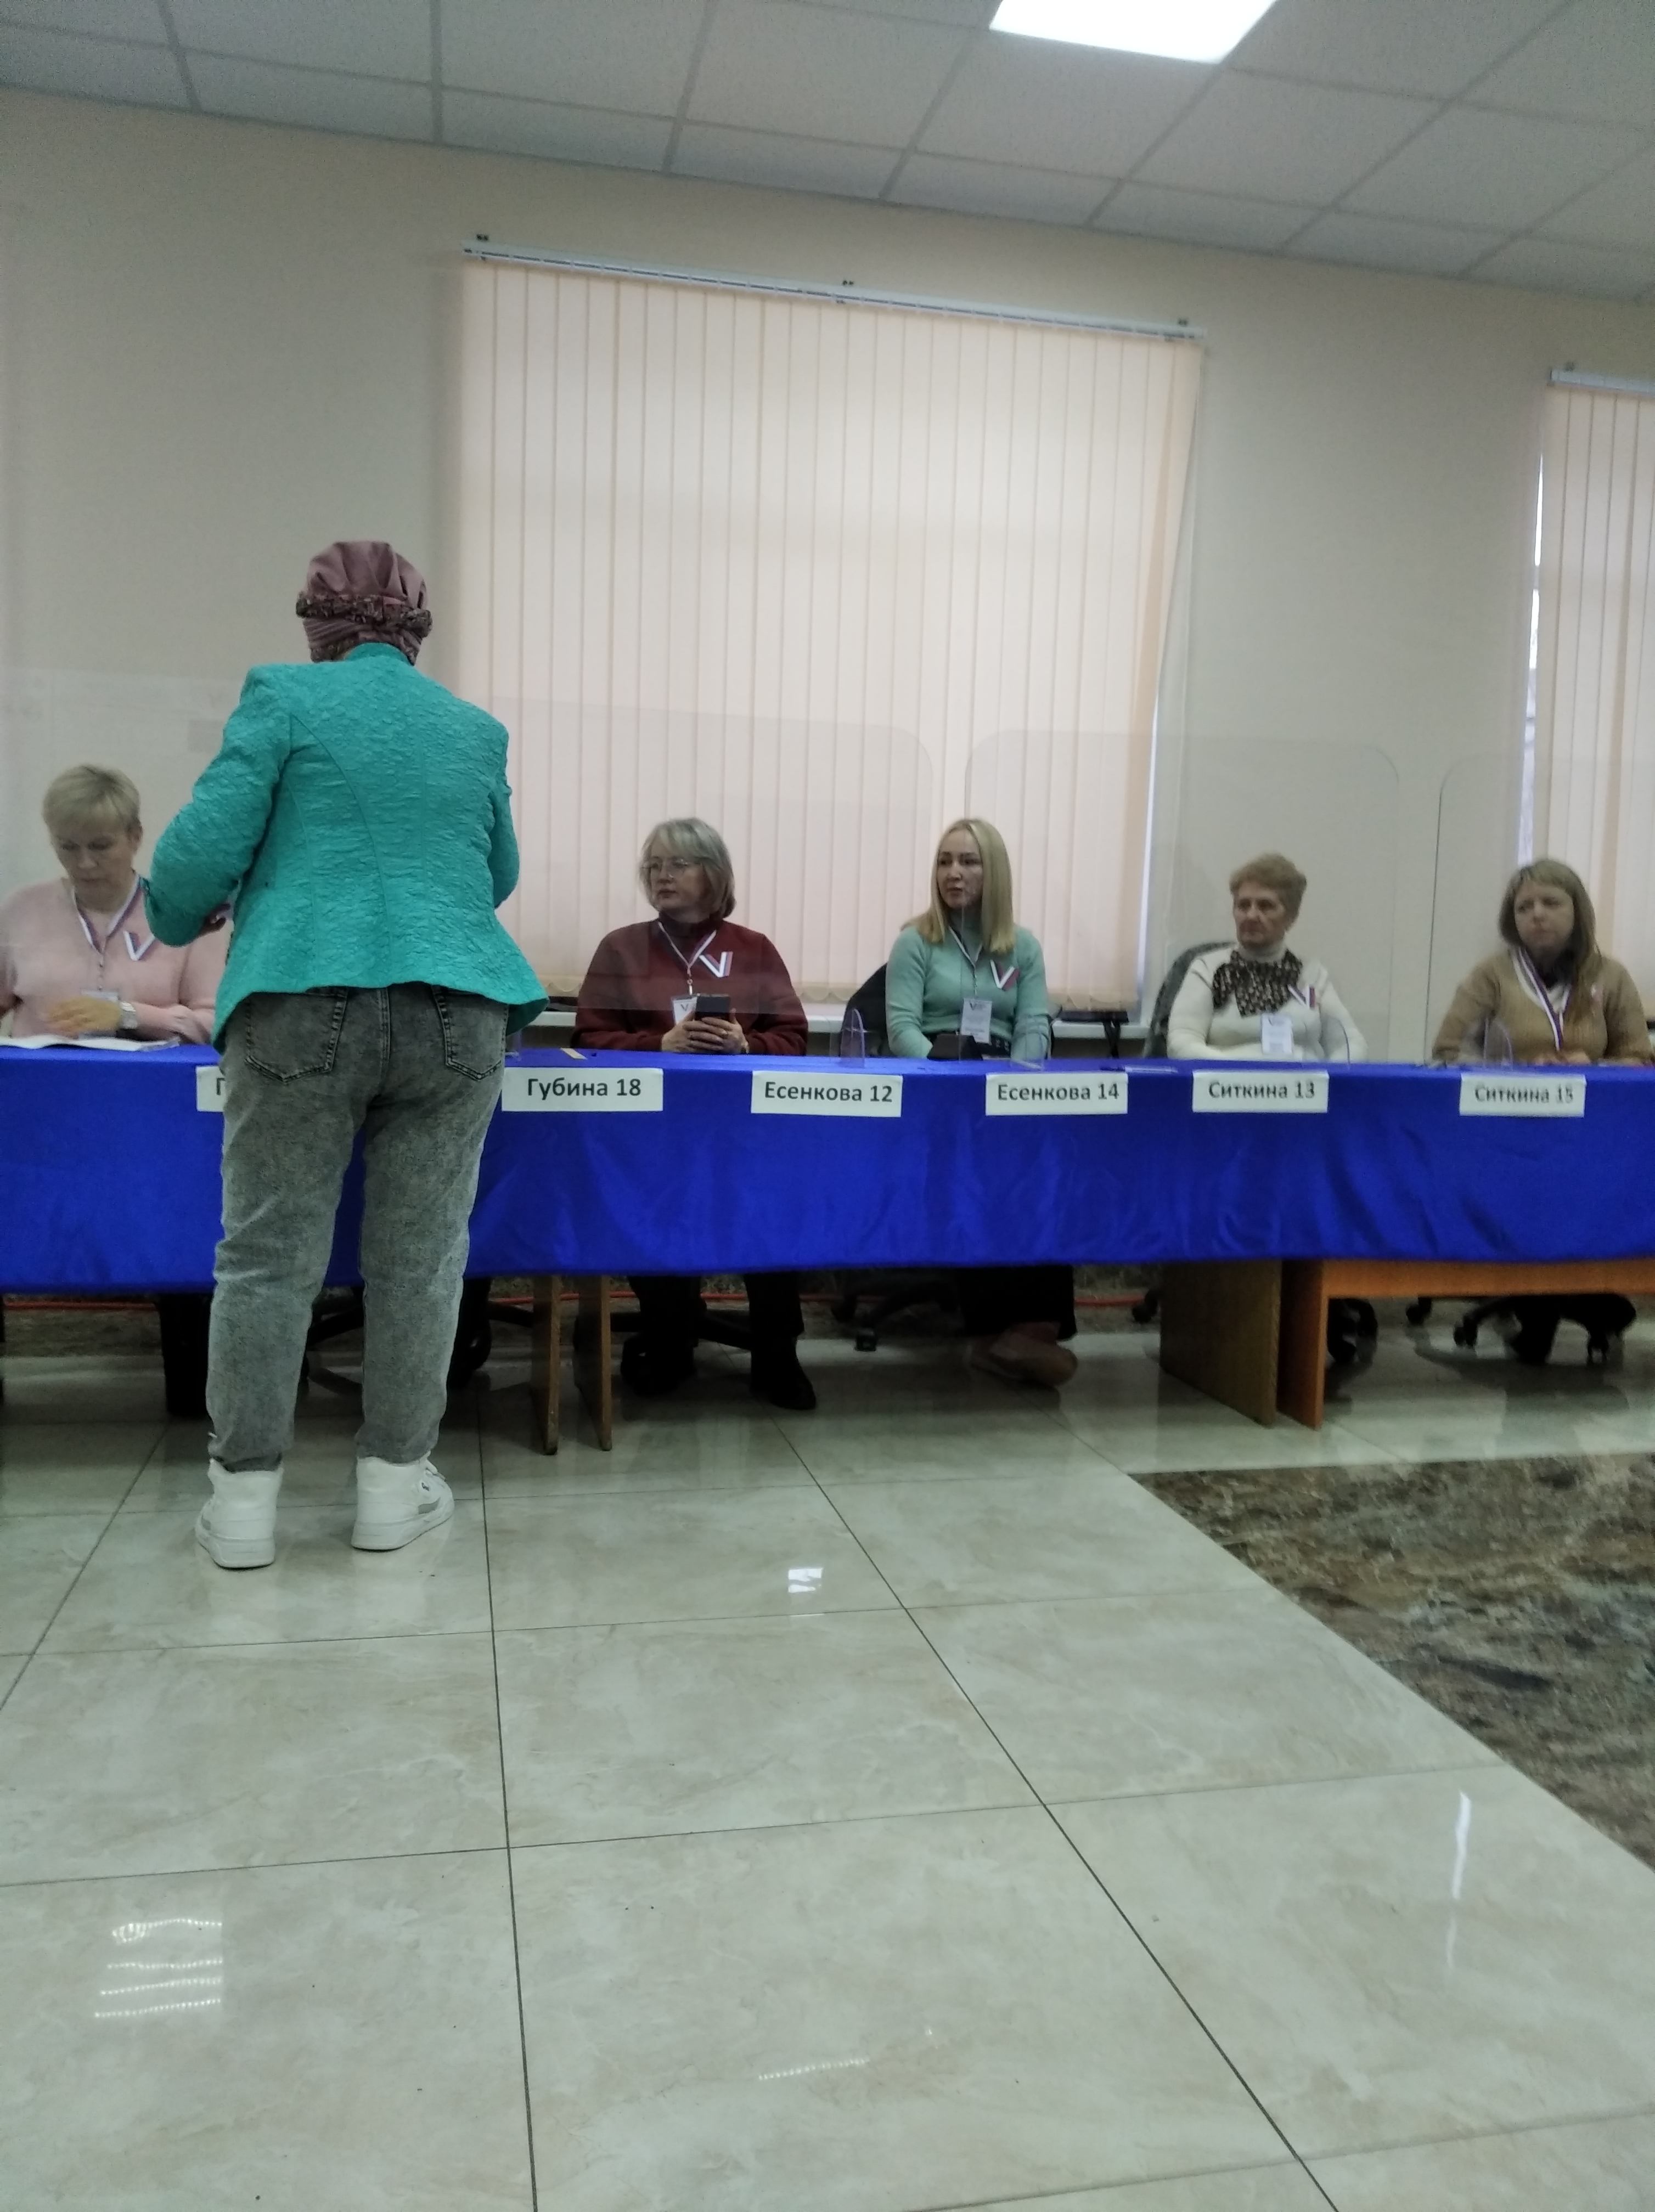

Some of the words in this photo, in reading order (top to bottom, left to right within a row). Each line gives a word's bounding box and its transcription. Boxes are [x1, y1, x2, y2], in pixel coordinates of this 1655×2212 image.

[527, 1076, 608, 1101] Губина
[616, 1077, 641, 1097] 18
[764, 1081, 863, 1102] Есенкова
[870, 1085, 893, 1103] 12
[998, 1084, 1091, 1101] Есенкова
[1098, 1083, 1119, 1099] 14
[1208, 1081, 1287, 1098] Ситкина
[1294, 1081, 1315, 1098] 13
[1474, 1084, 1550, 1103] Ситкина
[1556, 1084, 1574, 1103] 15
